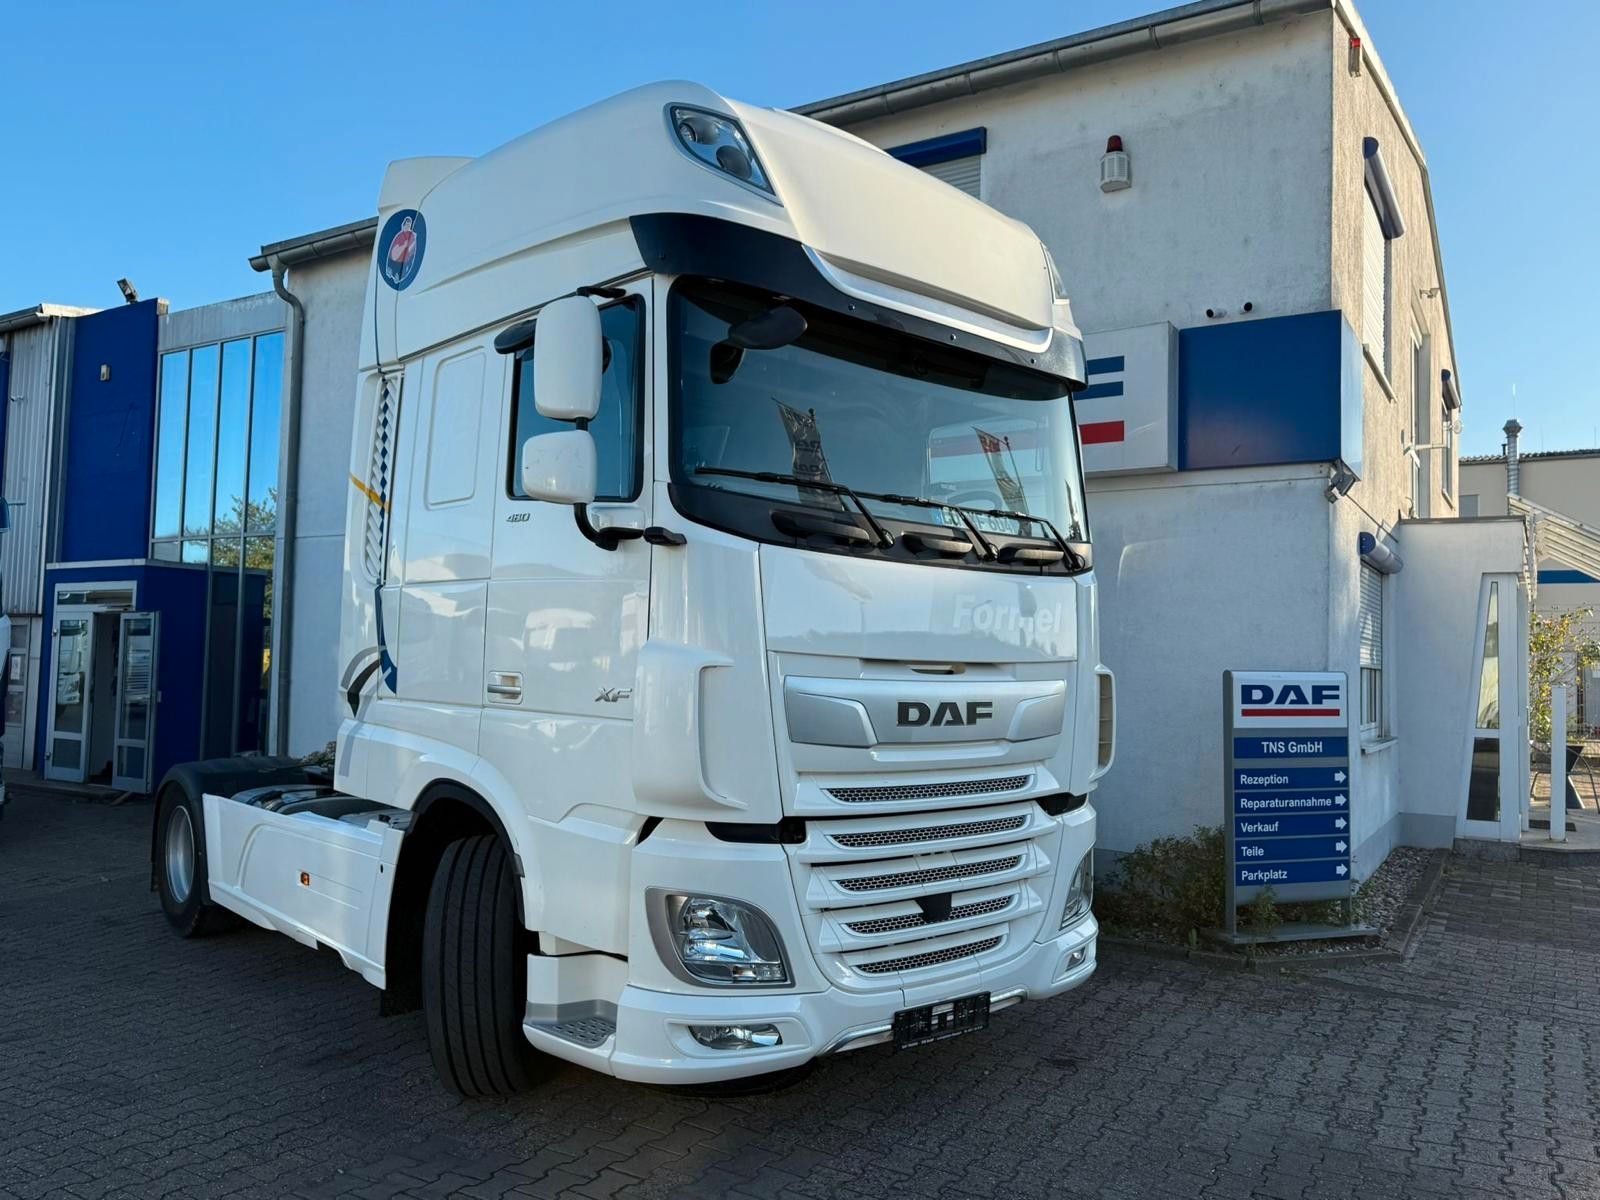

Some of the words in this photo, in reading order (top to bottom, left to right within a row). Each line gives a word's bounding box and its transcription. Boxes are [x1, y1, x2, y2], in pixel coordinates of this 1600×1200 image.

[594, 687, 633, 703] XF
[1241, 685, 1340, 705] DAF
[897, 701, 993, 727] DAF
[1261, 741, 1286, 753] TNS
[1288, 741, 1323, 753] GmbH
[1240, 774, 1289, 787] Rezeption
[1240, 796, 1332, 811] Reparaturannahme
[1240, 821, 1279, 833] Verkauf
[1241, 846, 1265, 857] Teile
[1241, 869, 1288, 882] Parkplatz
